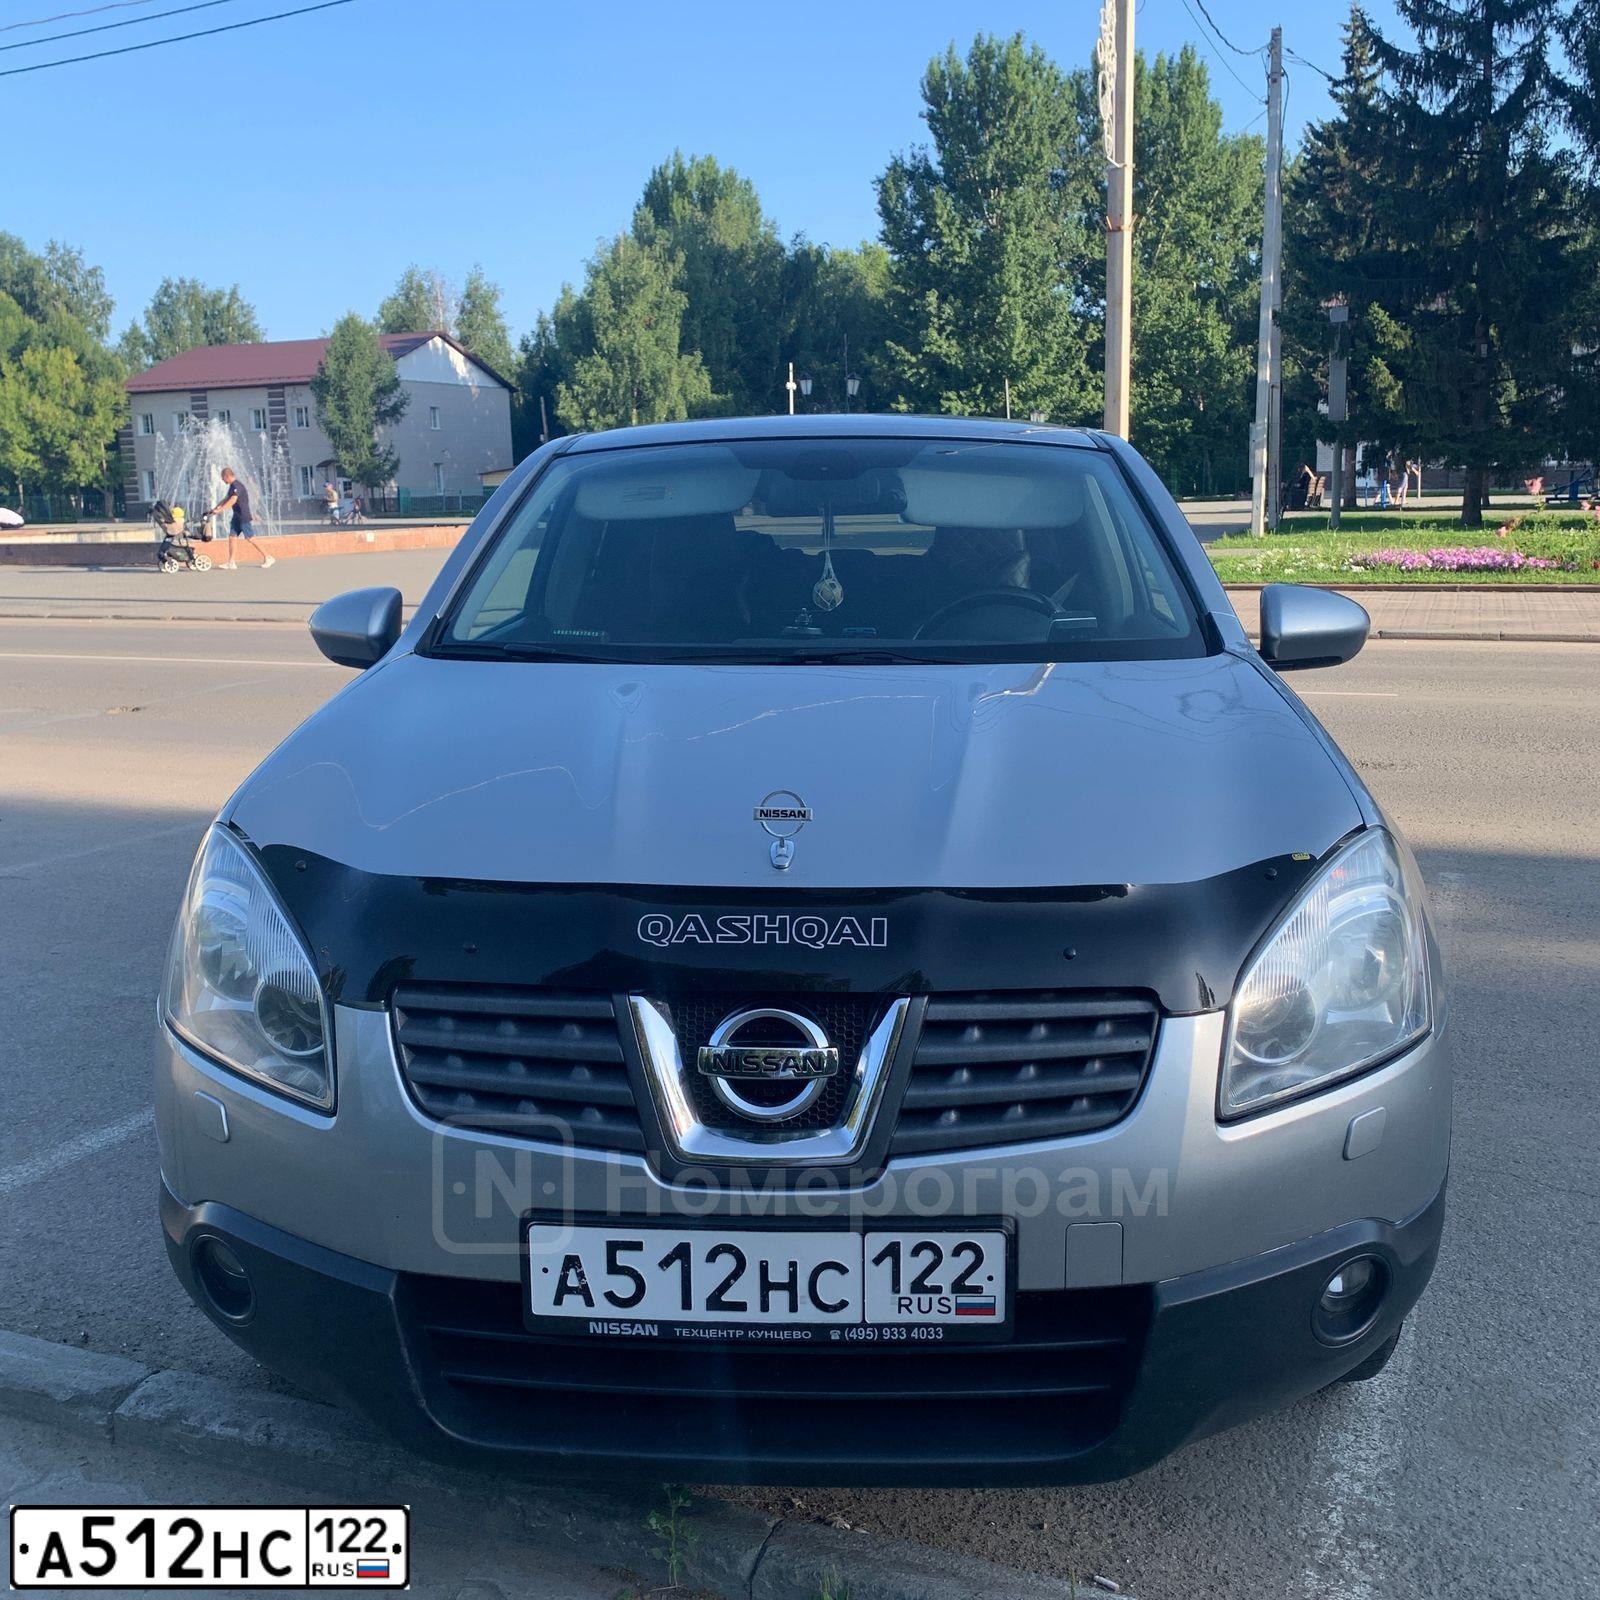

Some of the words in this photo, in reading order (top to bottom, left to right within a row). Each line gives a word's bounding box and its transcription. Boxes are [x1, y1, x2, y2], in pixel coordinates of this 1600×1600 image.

[759, 808, 807, 819] NISSAN
[637, 913, 888, 949] QASHQAI
[712, 1052, 823, 1073] NISSAN
[870, 1240, 985, 1295] 122
[897, 1296, 952, 1315] RUS
[588, 1321, 659, 1337] NISSAN
[674, 1327, 746, 1340] ТЕХЦЕНТР
[747, 1329, 812, 1341] КУНЦЕВО
[844, 1327, 878, 1342] (495)
[881, 1327, 907, 1340] 933
[909, 1327, 944, 1340] 4033
